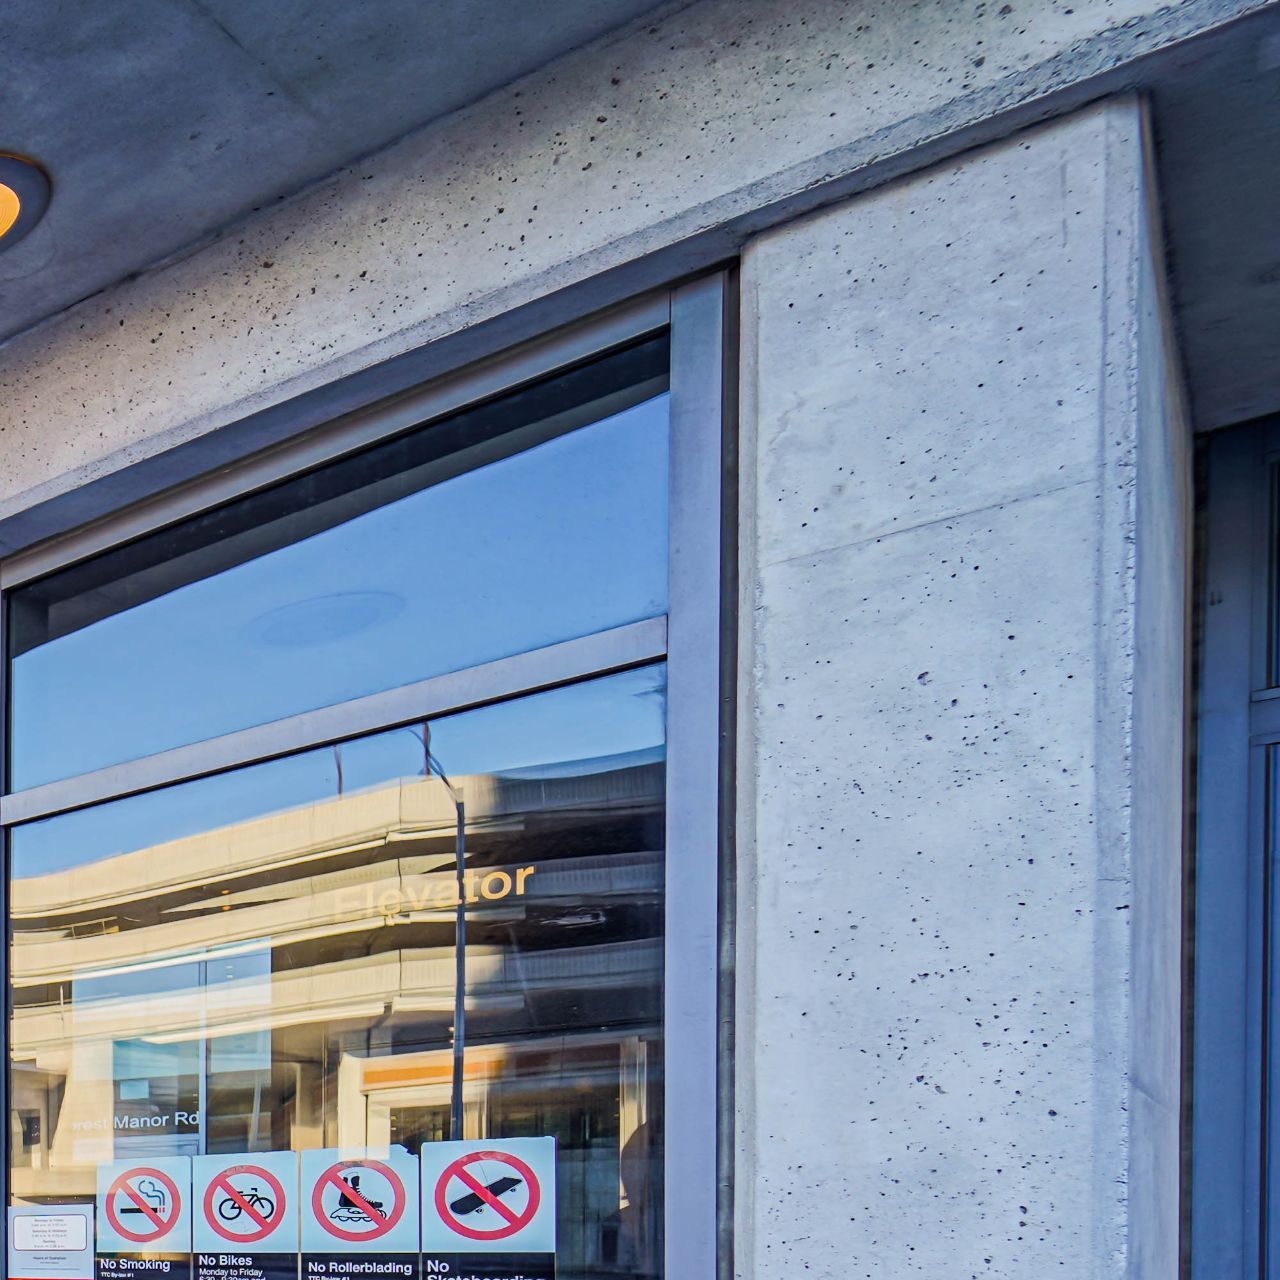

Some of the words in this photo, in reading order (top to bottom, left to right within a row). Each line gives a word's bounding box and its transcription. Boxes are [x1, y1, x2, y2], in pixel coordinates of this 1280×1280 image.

[333, 866, 535, 921] Elevator
[114, 1115, 169, 1129] Manor
[175, 1111, 200, 1125] Rd
[100, 1259, 116, 1269] No
[119, 1259, 171, 1272] Smoking
[199, 1255, 217, 1266] No
[219, 1255, 252, 1266] Bikes
[427, 1260, 449, 1272] No
[199, 1268, 228, 1277] Monday
[229, 1268, 238, 1276] to
[239, 1268, 263, 1277] Friday
[308, 1262, 326, 1272] No
[329, 1262, 413, 1275] Rollerblading
